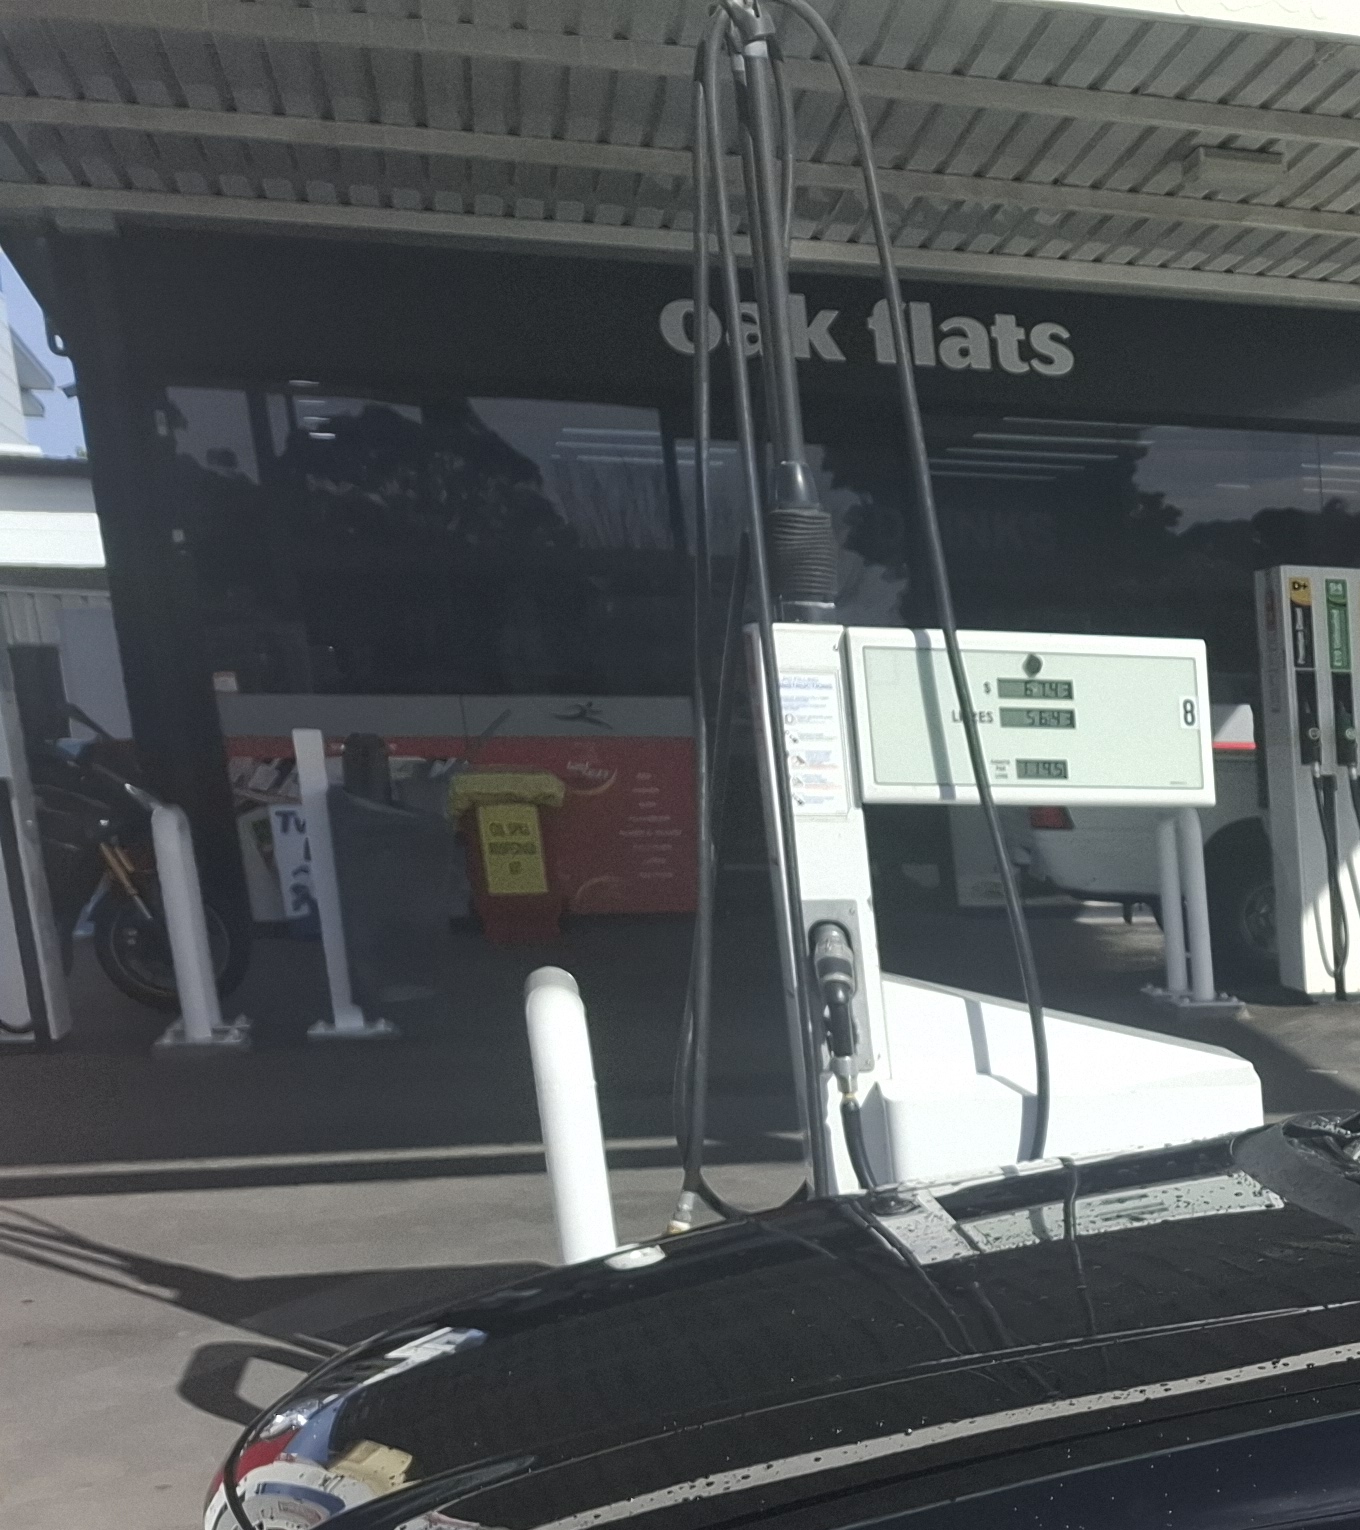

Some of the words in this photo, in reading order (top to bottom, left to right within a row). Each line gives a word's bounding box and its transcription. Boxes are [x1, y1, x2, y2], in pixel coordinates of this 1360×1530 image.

[867, 299, 1075, 375] flats
[876, 508, 1057, 551] DINKS
[1182, 698, 1196, 727] 8
